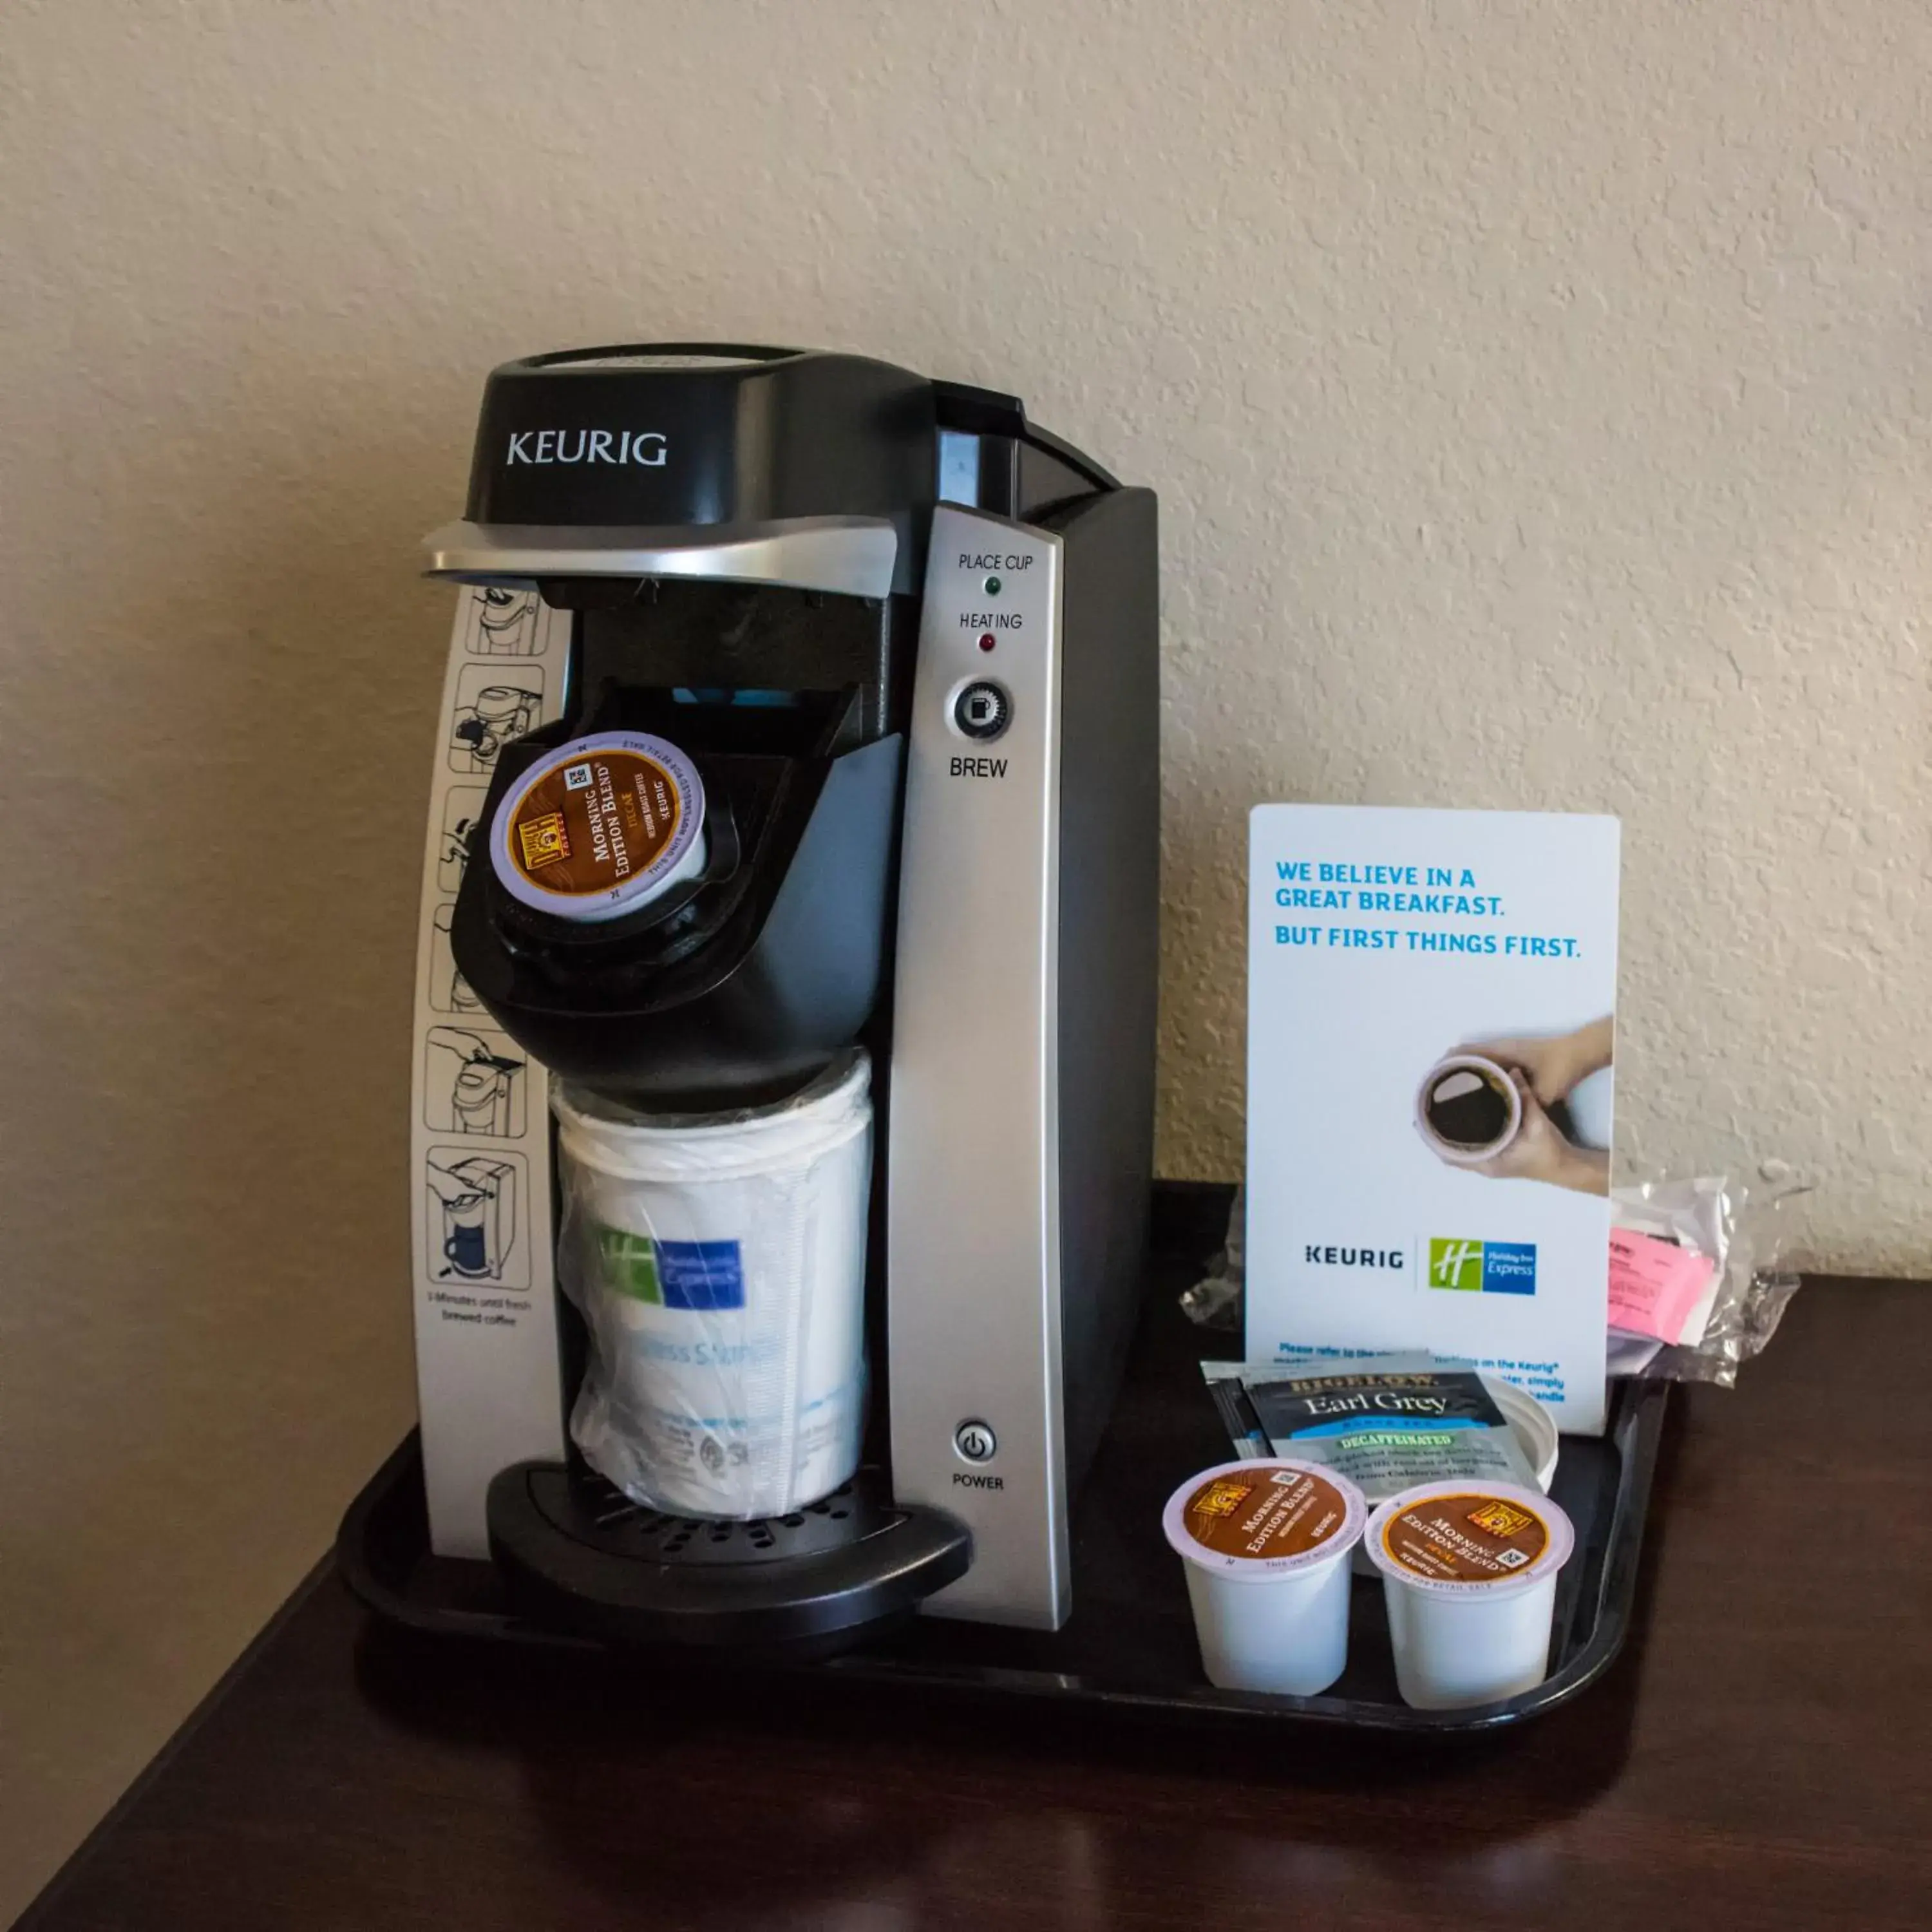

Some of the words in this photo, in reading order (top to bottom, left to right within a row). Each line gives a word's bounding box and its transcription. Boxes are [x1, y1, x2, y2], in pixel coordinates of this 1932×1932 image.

[506, 430, 668, 465] KEURIG
[958, 554, 1001, 569] PLACE
[1005, 555, 1033, 570] CUP
[960, 613, 1023, 629] HEATING
[950, 757, 1008, 778] BREW
[654, 781, 671, 820] KEURIG
[607, 815, 630, 878] EDITION
[1276, 862, 1312, 881] WE
[1319, 863, 1418, 886] BELIEVE
[1426, 867, 1452, 887] IN
[1460, 869, 1476, 888] A
[1275, 888, 1352, 909] GREAT
[1358, 891, 1506, 916] BREAKFAST.
[1275, 925, 1322, 945] BUT
[1329, 927, 1399, 949] FIRST
[1406, 931, 1497, 954] THINGS
[1504, 936, 1582, 958] FIRST.
[1305, 1245, 1405, 1269] KEURIG
[1488, 1261, 1534, 1278] Express
[1279, 1342, 1313, 1354] Please
[1497, 1359, 1515, 1369] the
[1528, 1377, 1564, 1390] simply
[1303, 1394, 1370, 1415] Earl
[1374, 1392, 1448, 1415] Grey
[1341, 1434, 1452, 1449] DECAFFEINATED
[952, 1473, 1005, 1490] POWER
[1247, 1508, 1289, 1554] EDITION
[1401, 1513, 1456, 1549] EDITION
